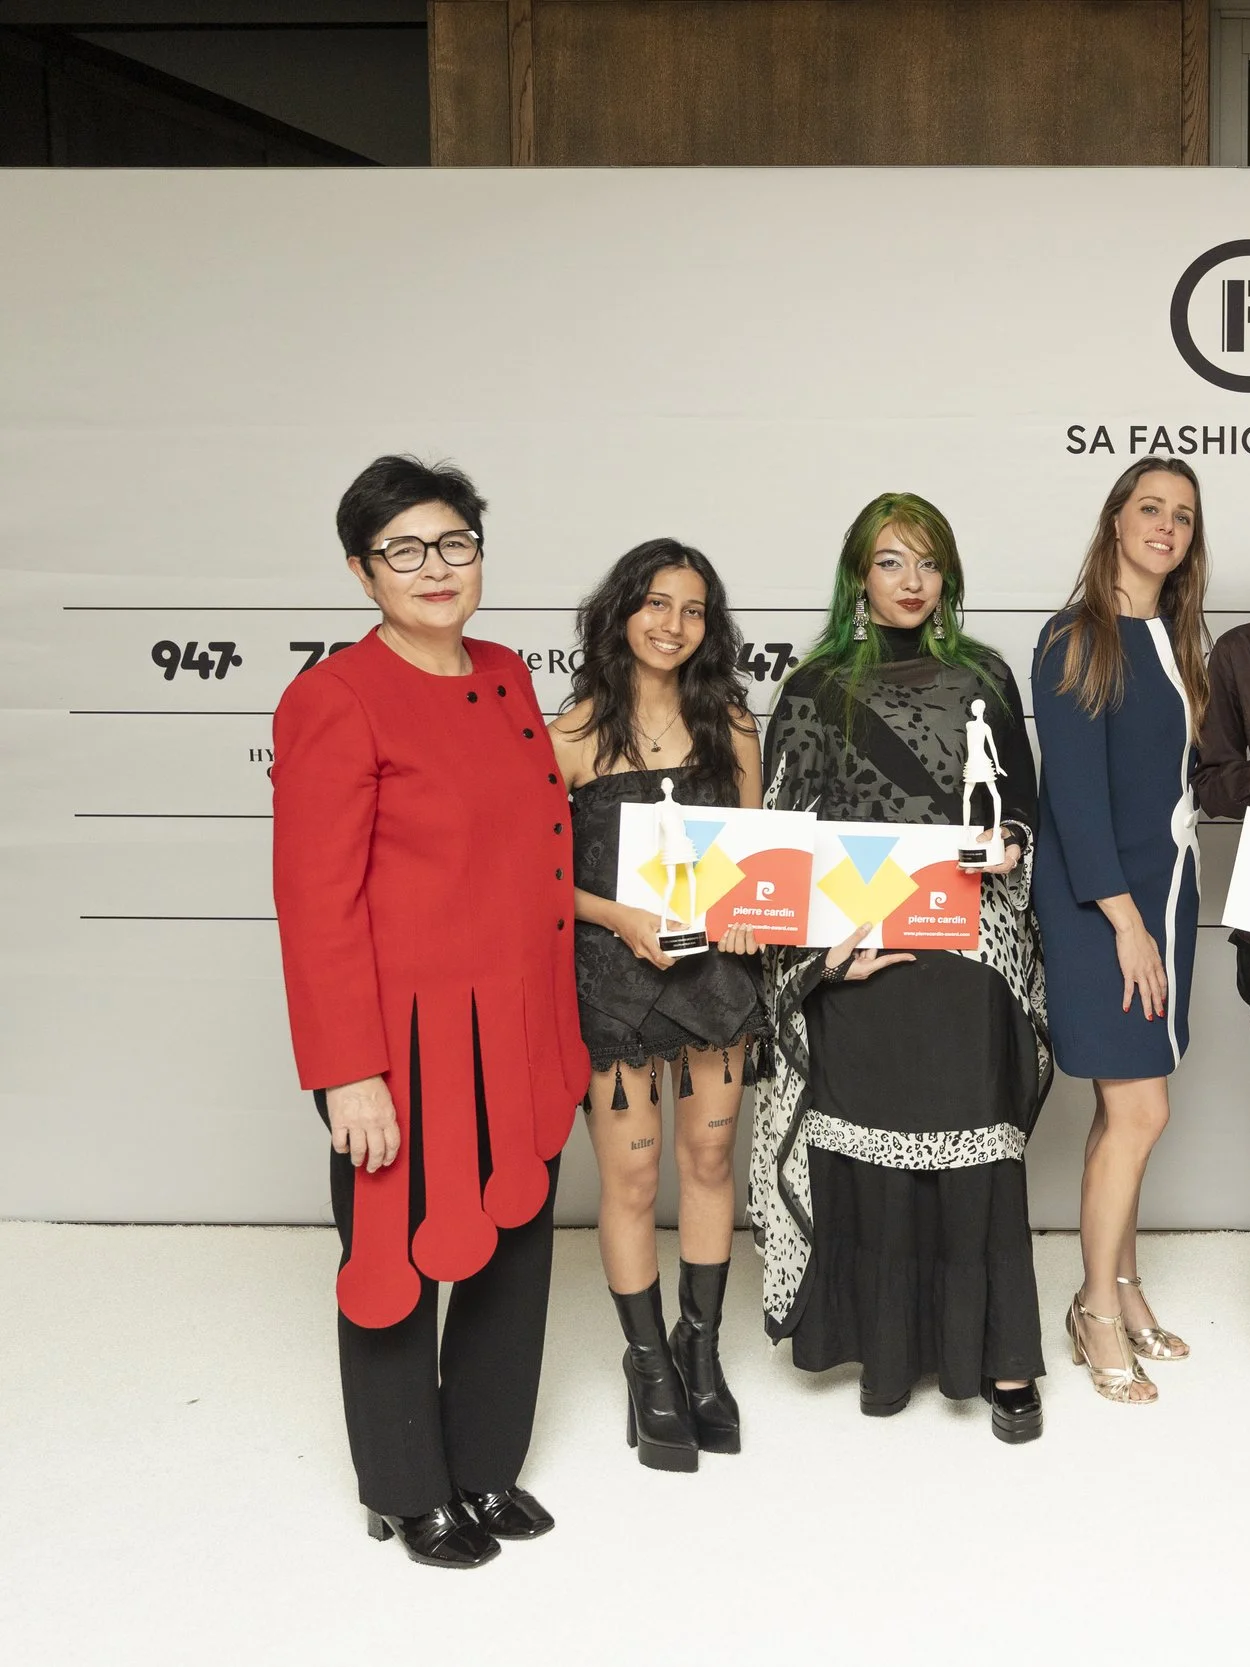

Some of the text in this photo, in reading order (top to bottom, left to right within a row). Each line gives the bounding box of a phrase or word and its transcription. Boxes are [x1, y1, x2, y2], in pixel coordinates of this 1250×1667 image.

[1066, 425, 1115, 455] SA
[733, 906, 795, 918] pierre cardin
[908, 914, 966, 925] pierre cardin
[708, 1115, 734, 1129] queen
[630, 1137, 655, 1151] killer
